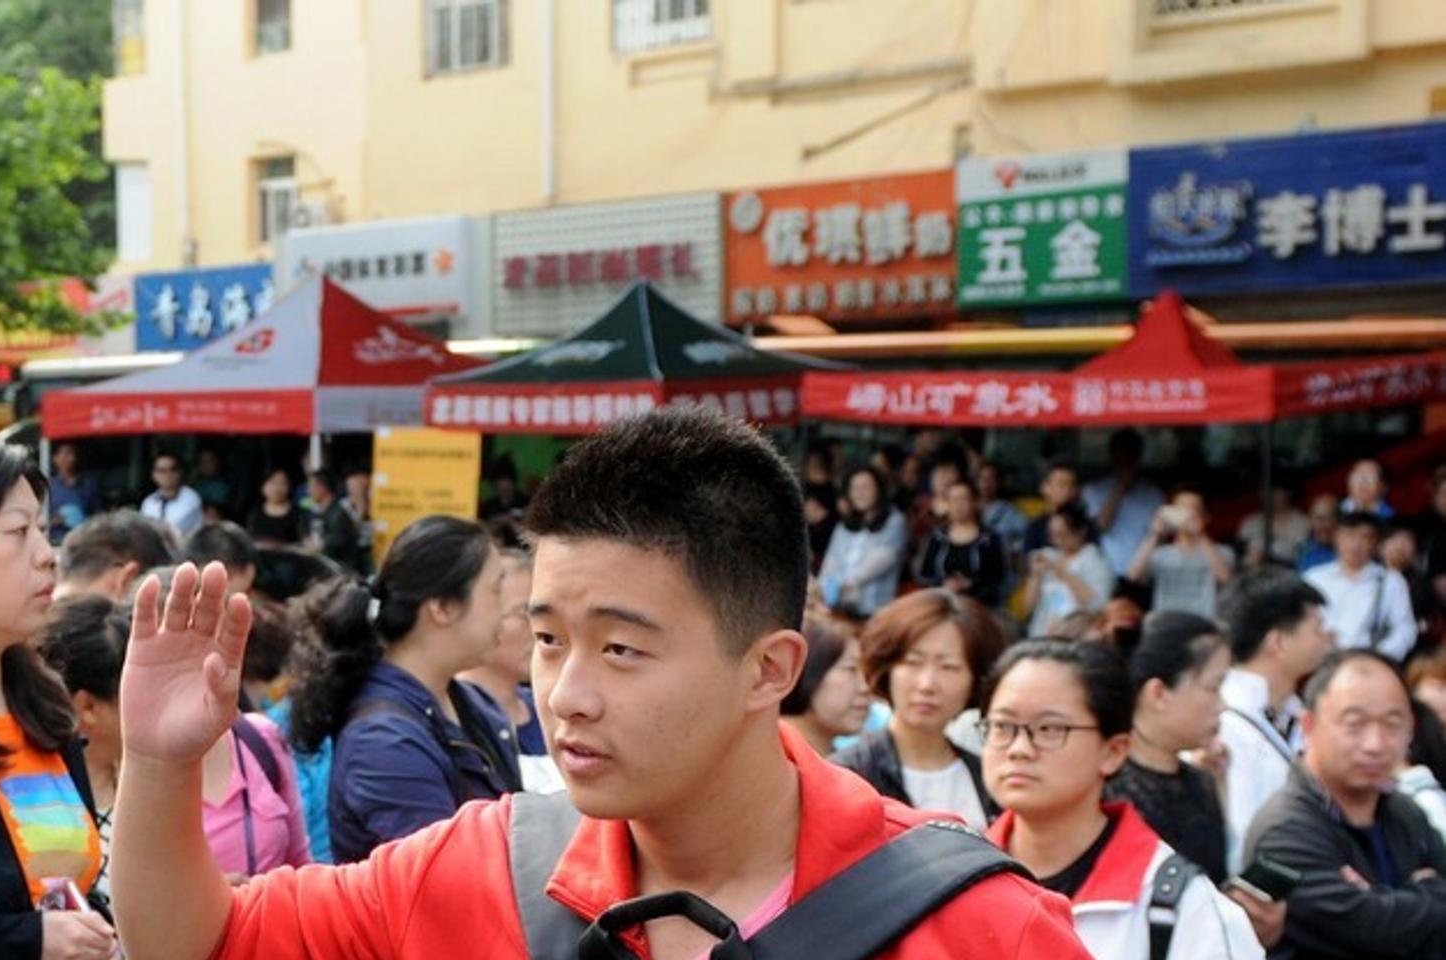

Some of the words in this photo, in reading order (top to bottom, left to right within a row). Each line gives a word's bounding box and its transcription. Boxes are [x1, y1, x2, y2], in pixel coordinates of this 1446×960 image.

[976, 220, 1103, 284] 五金
[1256, 183, 1446, 258] 李博士
